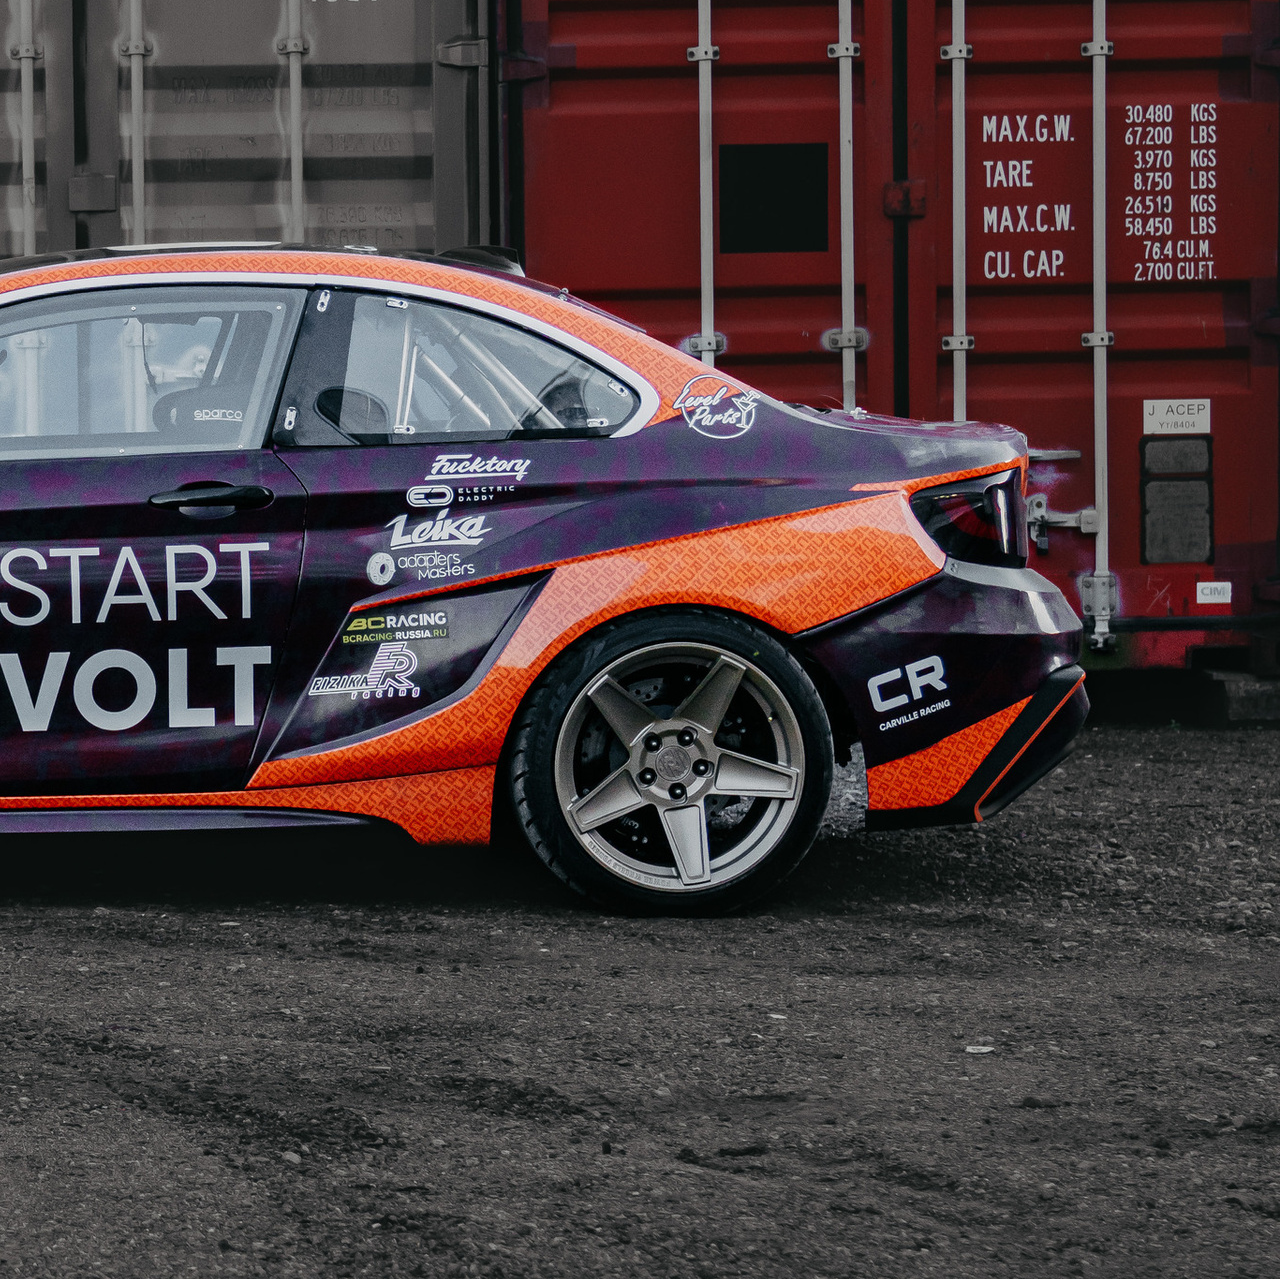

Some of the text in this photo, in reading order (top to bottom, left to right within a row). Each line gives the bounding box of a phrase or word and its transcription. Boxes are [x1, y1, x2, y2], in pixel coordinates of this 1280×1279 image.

[1190, 103, 1217, 122] KGS
[982, 114, 1075, 142] MAX.G.W.
[1190, 125, 1217, 144] LBS
[1190, 149, 1217, 167] KGS
[983, 160, 1033, 188] TARE
[1190, 171, 1217, 189] LBS
[1190, 194, 1217, 213] KGS
[983, 203, 1075, 233] MAX.C.W.
[1190, 216, 1217, 234] LBS
[1143, 239, 1213, 259] 76.4 CU.M.
[984, 250, 1064, 279] CU. CAP.
[672, 386, 728, 409] Level
[193, 409, 243, 422] sparco
[688, 406, 742, 428] Parts
[1165, 403, 1206, 416] ACEP
[429, 453, 531, 481] Fucktory
[458, 485, 515, 494] ELECTRIC
[458, 494, 495, 502] DADDY
[384, 508, 493, 549] Leika
[397, 550, 461, 569] adapters
[0, 542, 270, 627] START
[342, 628, 447, 644] BCRACING-RUSSIA.RU
[309, 674, 370, 693] FIZIKA
[867, 655, 948, 713] CR
[351, 687, 421, 700] racing
[879, 699, 951, 731] CARVILLE RACING
